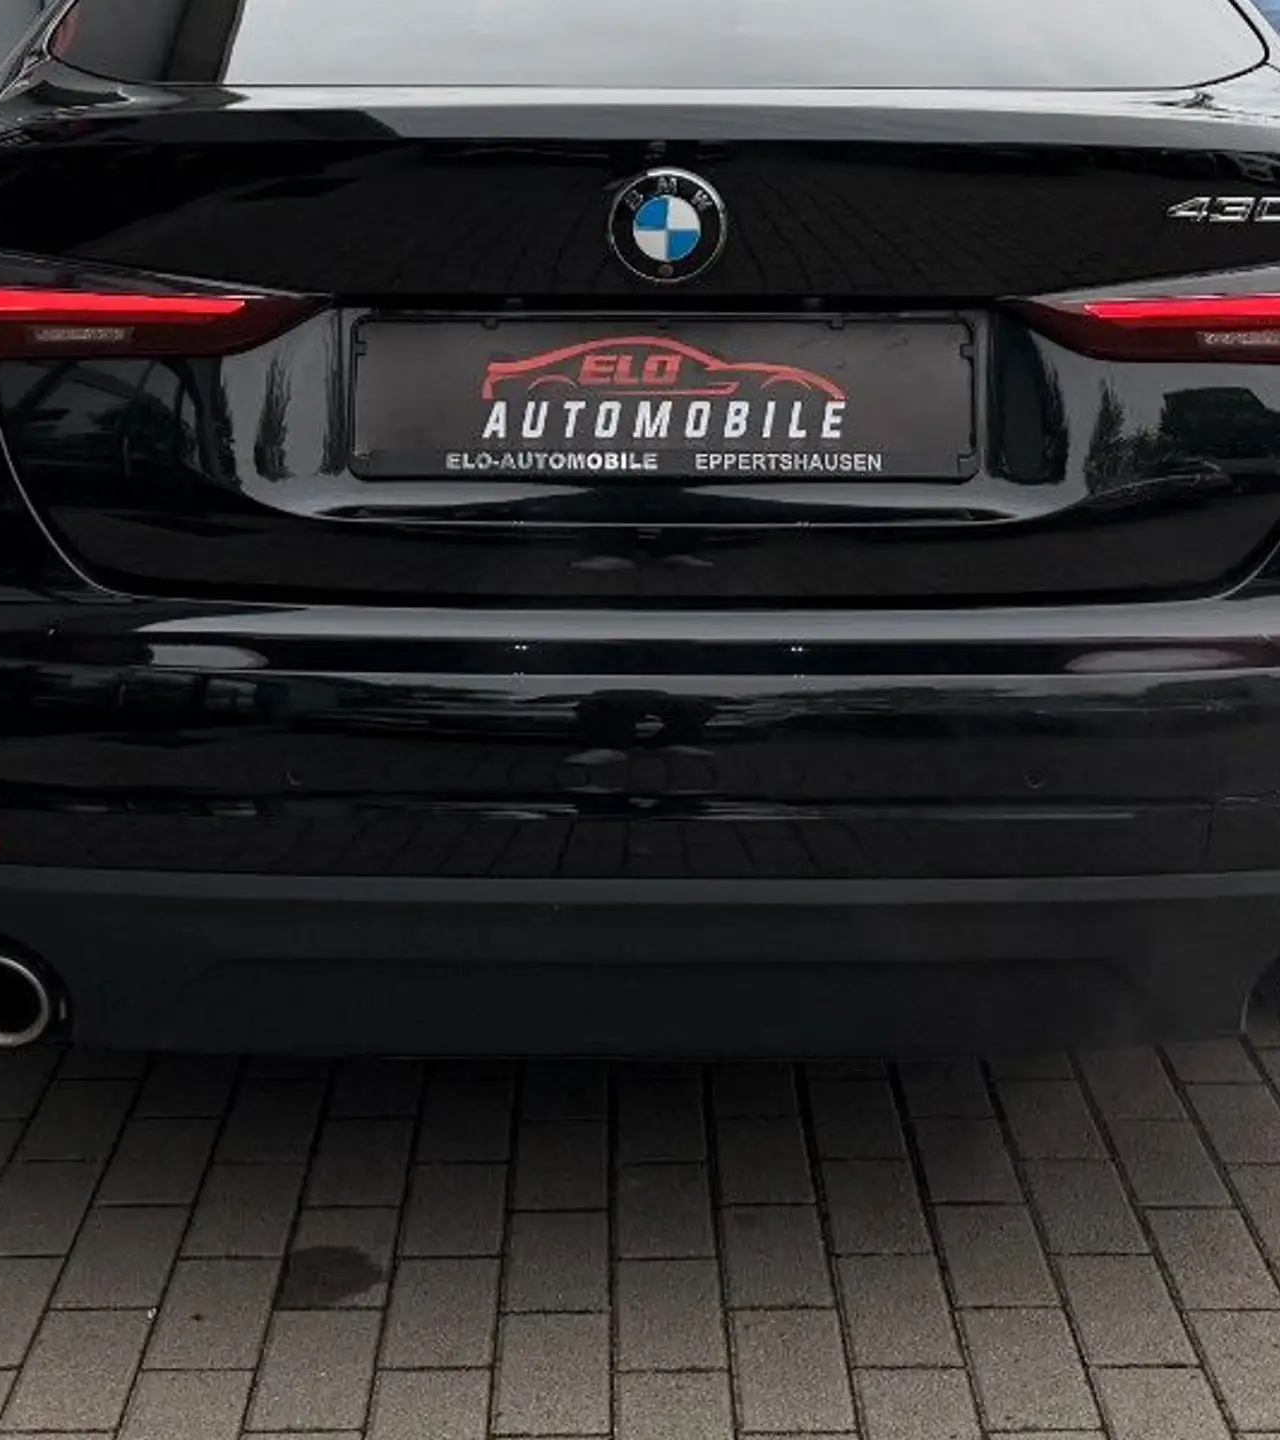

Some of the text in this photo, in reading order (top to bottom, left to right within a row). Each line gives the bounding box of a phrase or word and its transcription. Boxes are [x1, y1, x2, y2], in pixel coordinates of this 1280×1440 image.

[577, 354, 682, 385] ELO
[481, 399, 848, 440] AUTOMOBILE
[445, 452, 883, 472] ELO-AUTOMOBILE EPPERTSHAUSEN
